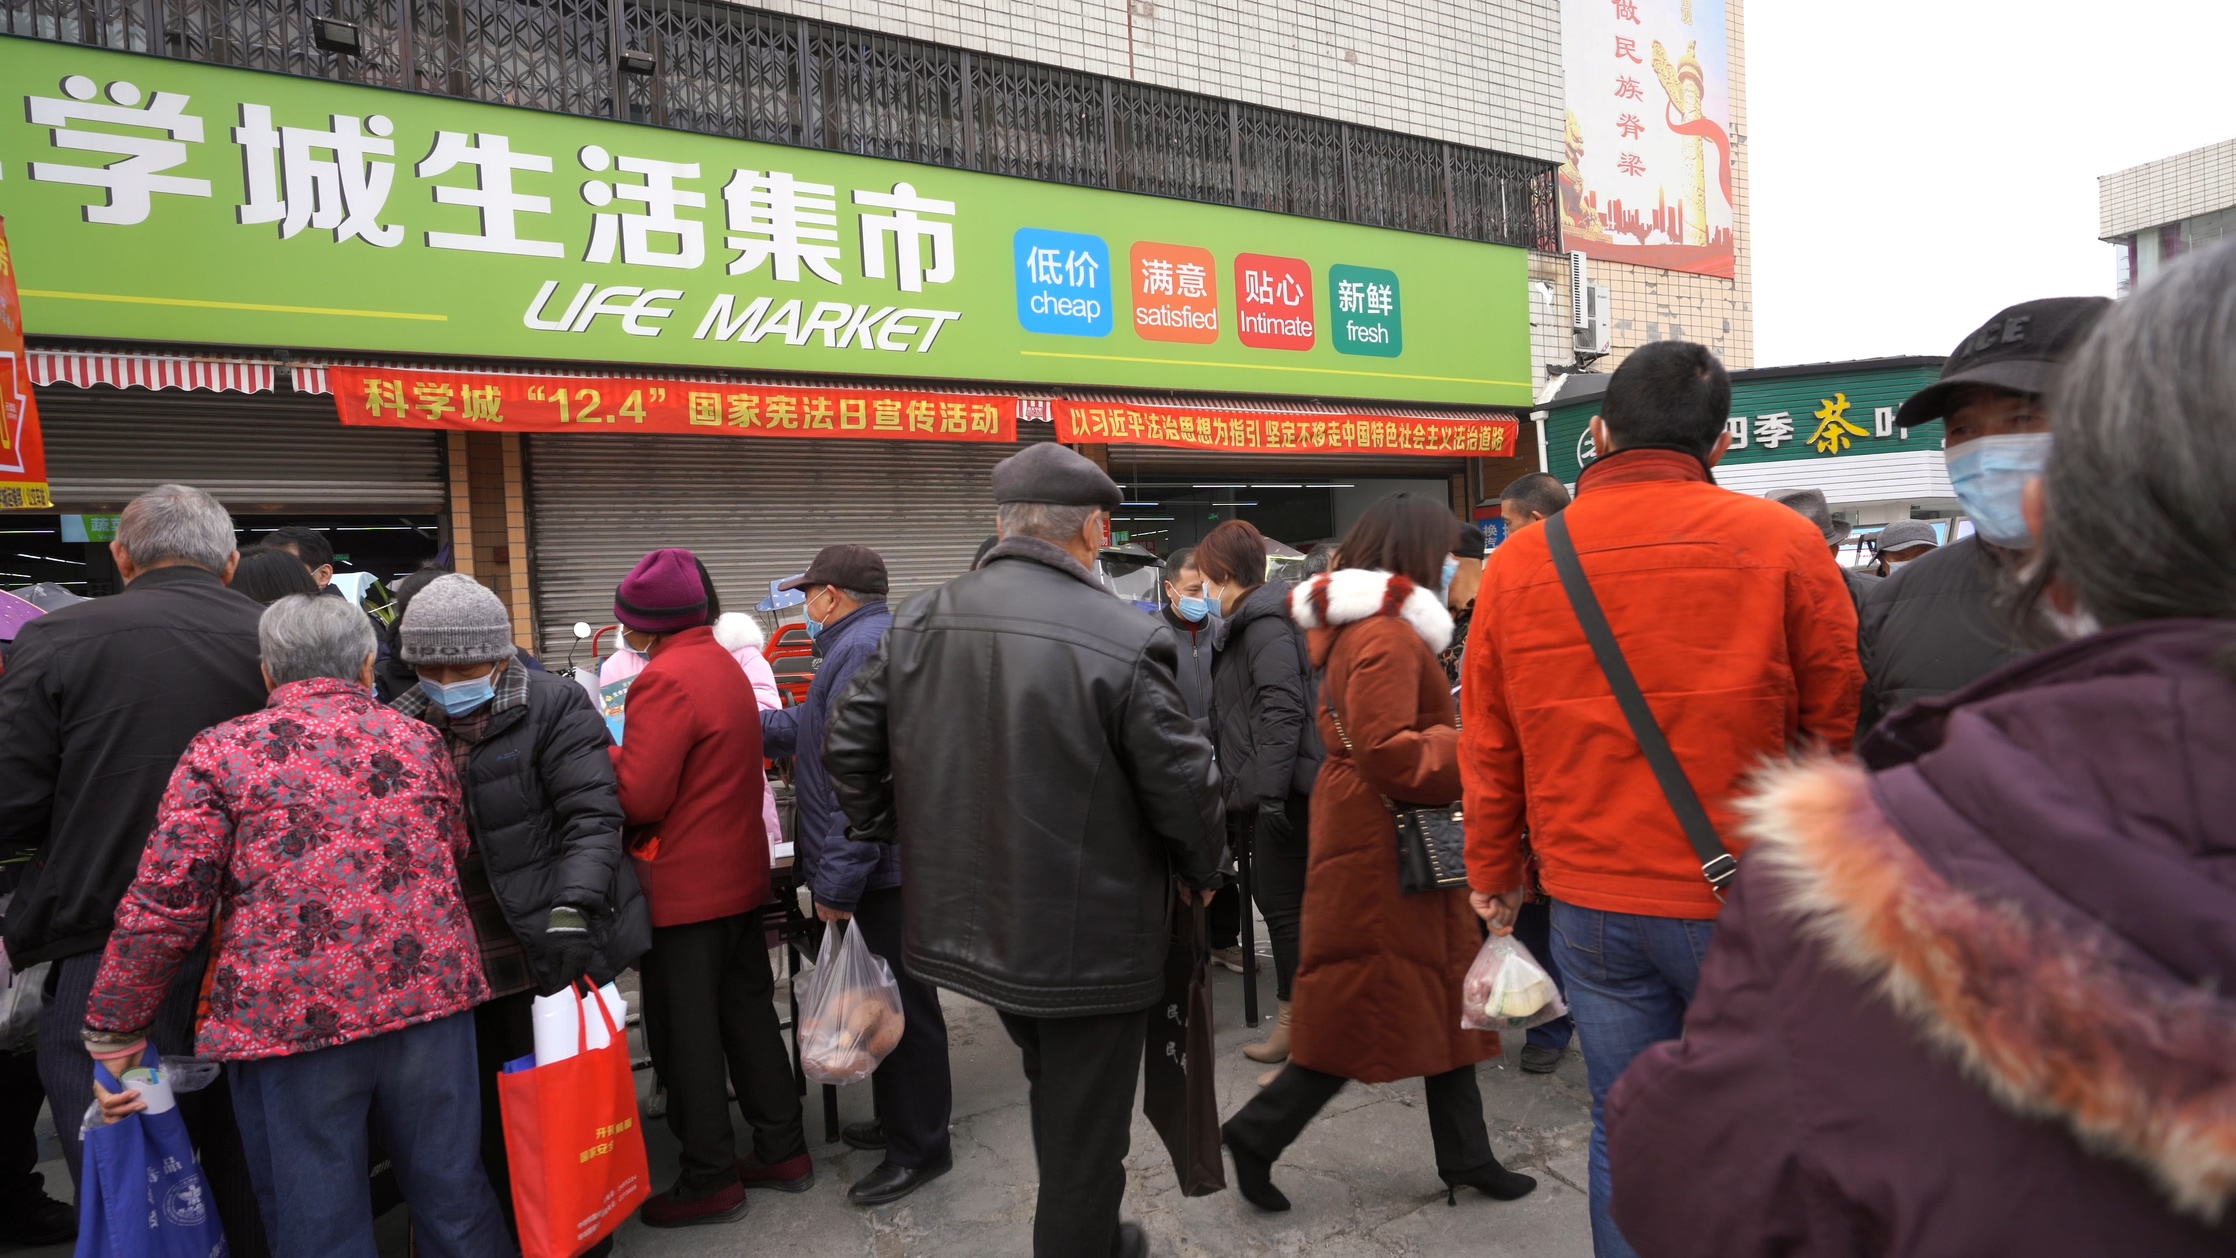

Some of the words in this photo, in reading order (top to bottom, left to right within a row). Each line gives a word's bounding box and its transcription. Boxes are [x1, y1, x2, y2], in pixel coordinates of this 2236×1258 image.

[0, 75, 956, 293] 学城生活集市
[1026, 245, 1099, 290] 低价
[1141, 258, 1208, 299] 满意
[1030, 291, 1101, 324] cheap
[1244, 270, 1305, 308] 贴心
[1338, 279, 1394, 317] 新鲜
[523, 280, 684, 337] LIFE
[693, 294, 962, 353] MARKET
[1136, 302, 1217, 331] satisfied
[1240, 310, 1313, 339] Intimate
[1346, 319, 1389, 344] fresh
[364, 378, 504, 423] 科学城
[689, 390, 999, 435] 国家宪法日宣传活动
[1070, 408, 1261, 448] 以习近平法治思想为指引
[1266, 420, 1504, 451] 坚定不移走中国特色社会主义法治道路
